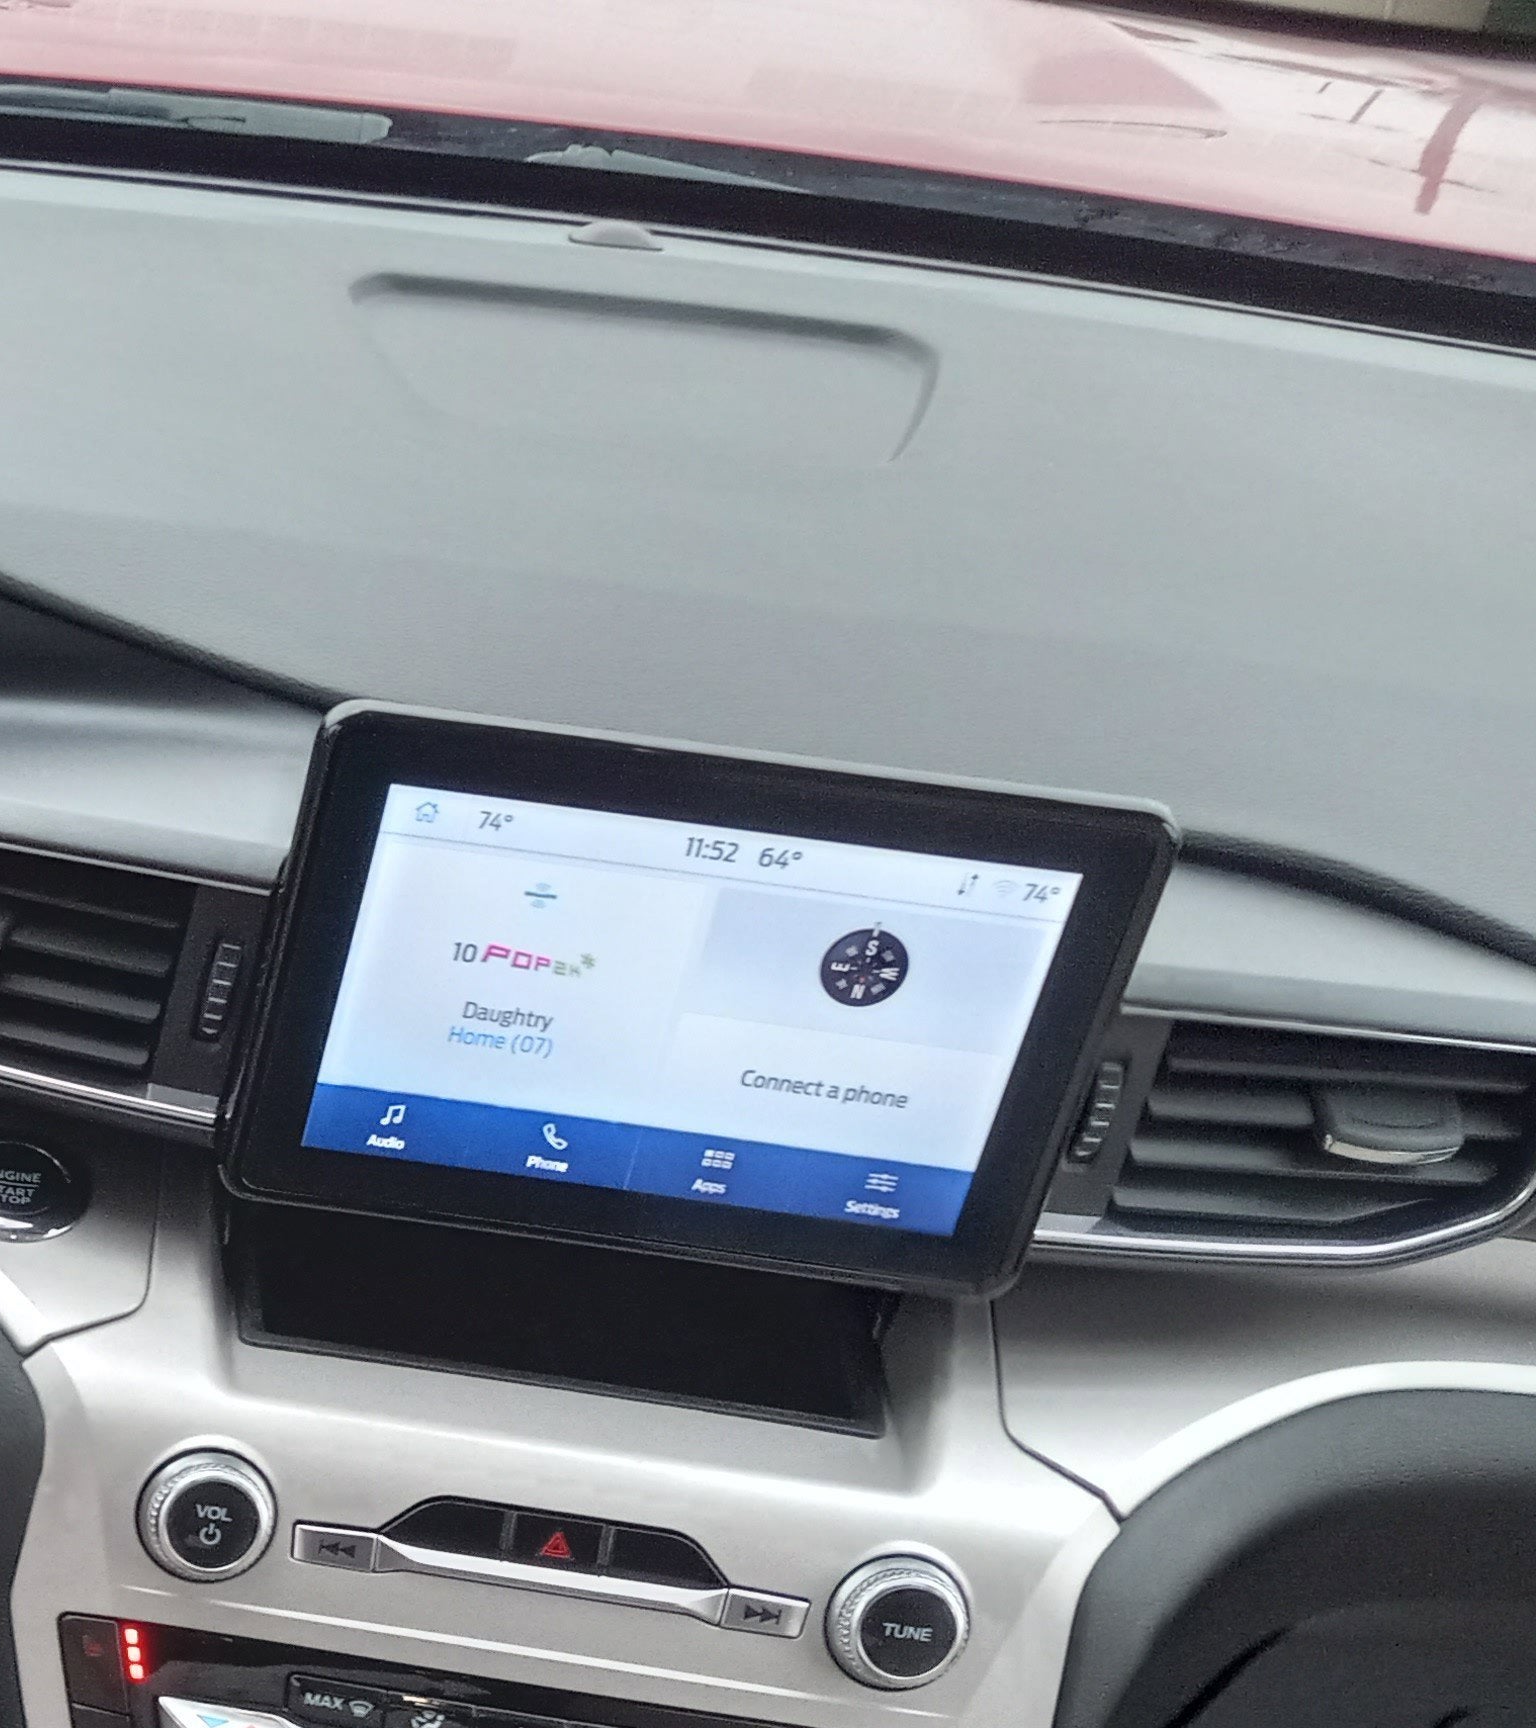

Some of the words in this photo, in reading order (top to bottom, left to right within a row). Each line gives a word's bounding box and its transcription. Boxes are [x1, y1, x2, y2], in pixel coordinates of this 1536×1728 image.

[477, 809, 513, 832] 74°
[685, 836, 740, 863] 11:52
[758, 846, 803, 870] 64°
[1023, 882, 1062, 905] 74°
[453, 942, 478, 964] 10
[865, 940, 880, 956] S
[831, 961, 850, 973] E
[879, 967, 900, 981] W
[850, 983, 866, 1000] N
[462, 1001, 554, 1033] Daughtry
[448, 1026, 506, 1051] Home
[511, 1033, 553, 1059] (07)
[740, 1069, 824, 1098] Connect
[827, 1086, 840, 1101] a
[841, 1085, 909, 1109] phone
[366, 1133, 405, 1151] Audio
[526, 1155, 569, 1173] Phone
[691, 1177, 726, 1195] Apps
[845, 1199, 900, 1220] Settings
[195, 1503, 232, 1522] VOL
[882, 1621, 933, 1643] TUNE
[304, 1692, 344, 1712] MAX
